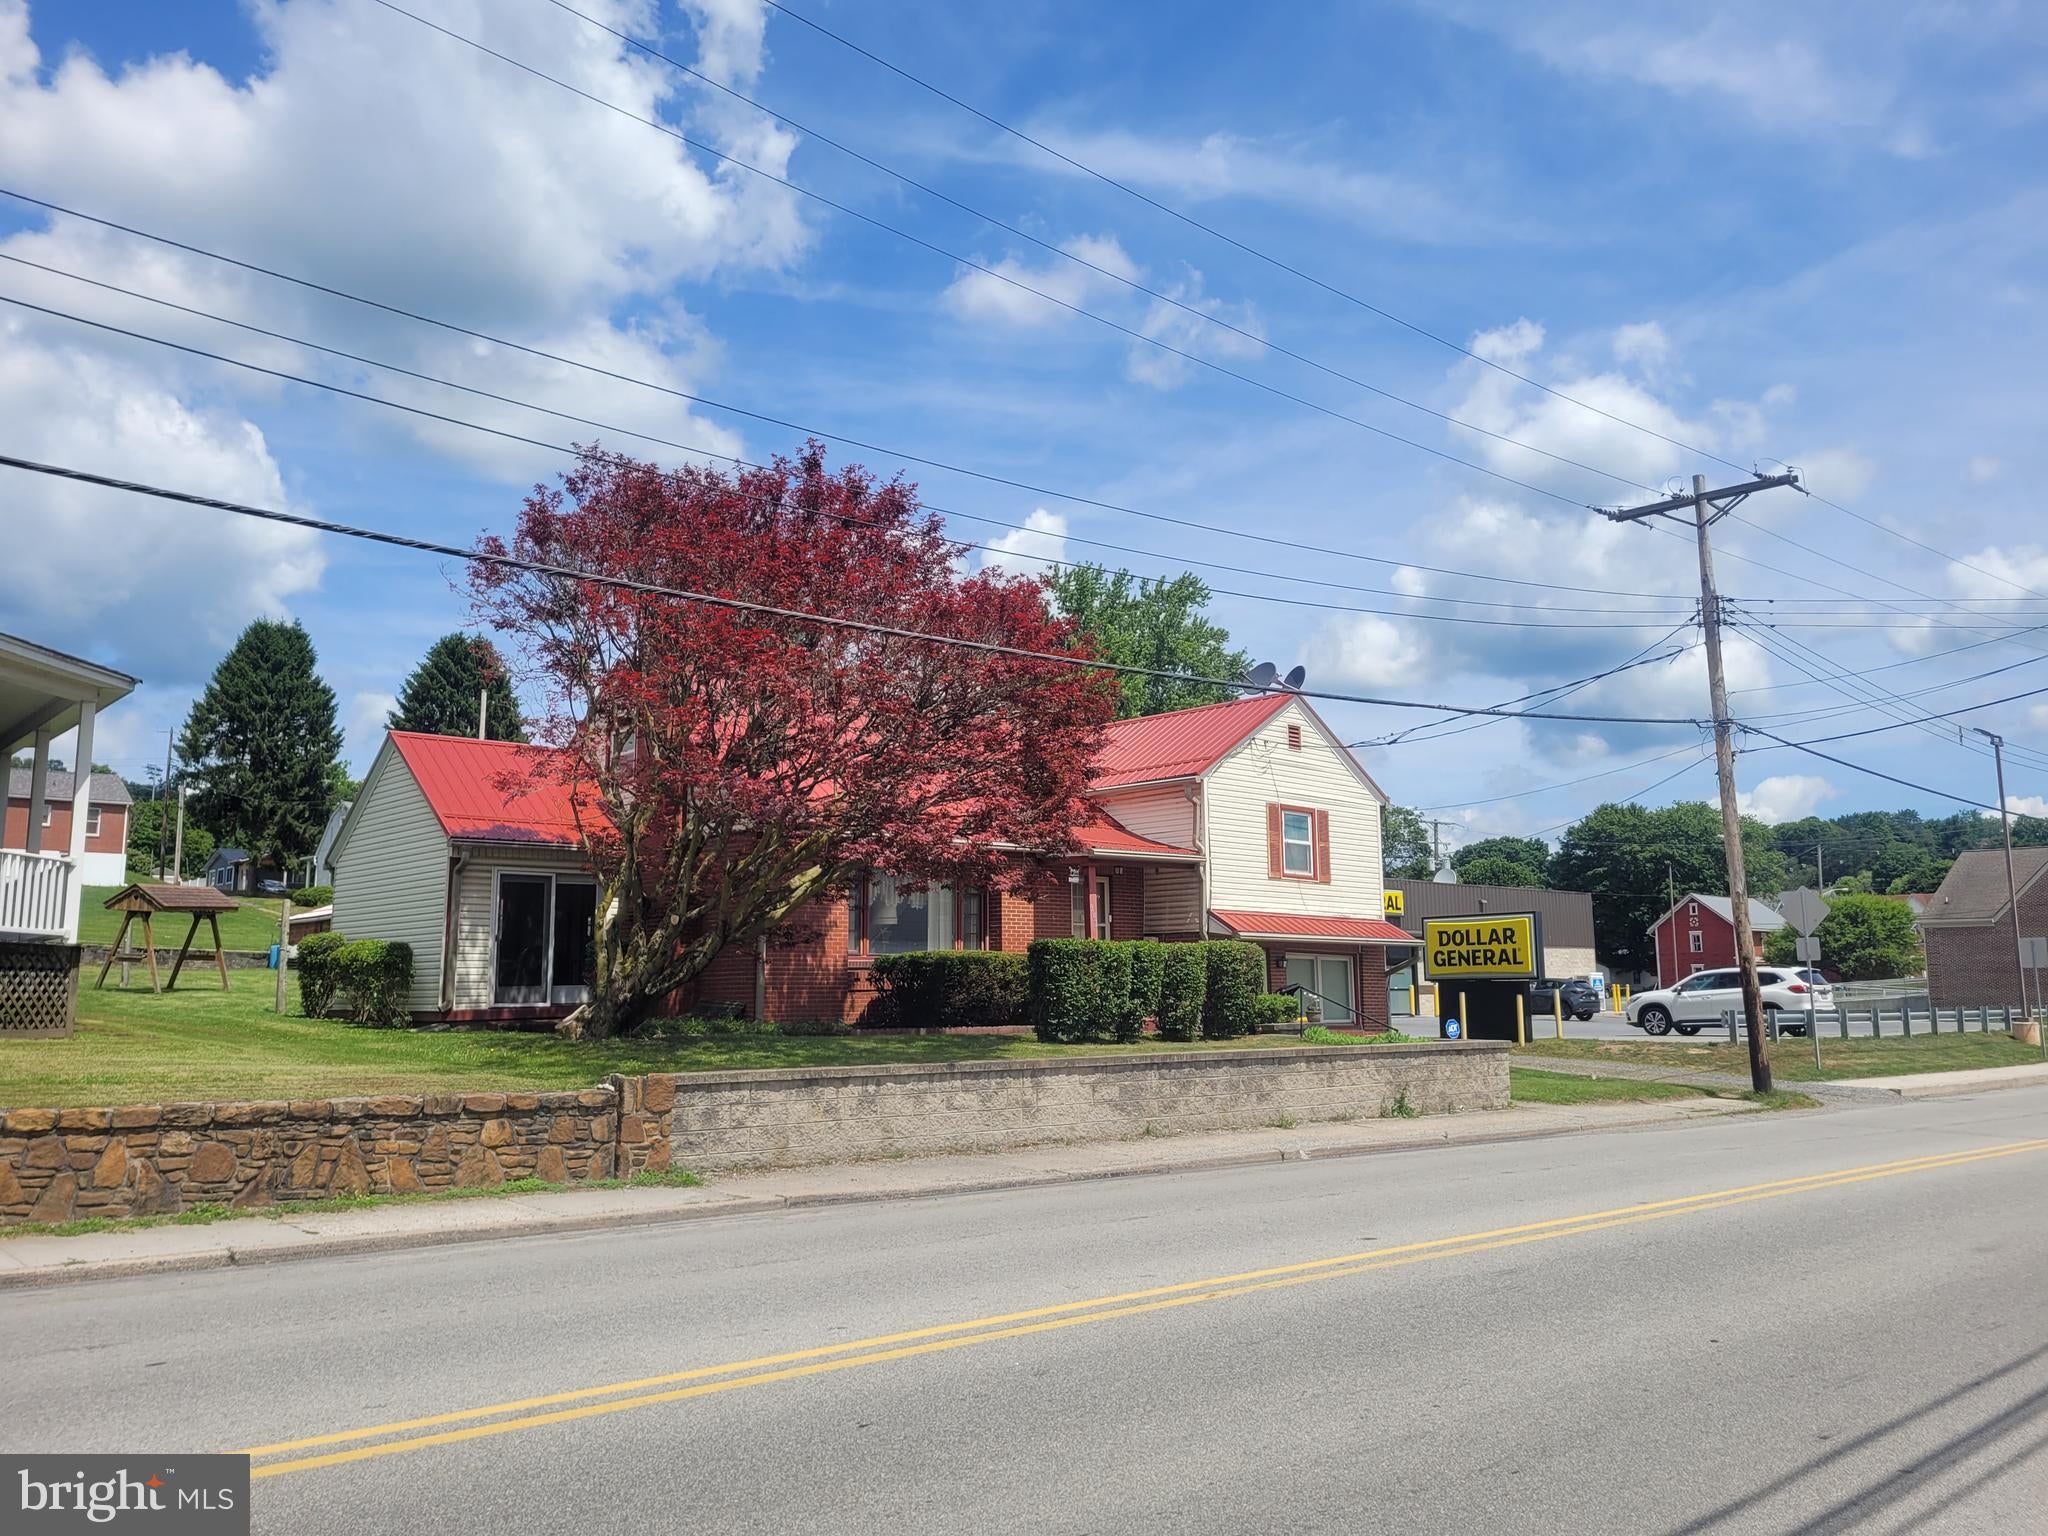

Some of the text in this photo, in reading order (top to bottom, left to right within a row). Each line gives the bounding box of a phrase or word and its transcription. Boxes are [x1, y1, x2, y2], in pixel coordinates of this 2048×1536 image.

[1384, 895, 1401, 911] AL
[1437, 927, 1516, 947] DOLLAR
[1433, 948, 1523, 967] GENERAL
